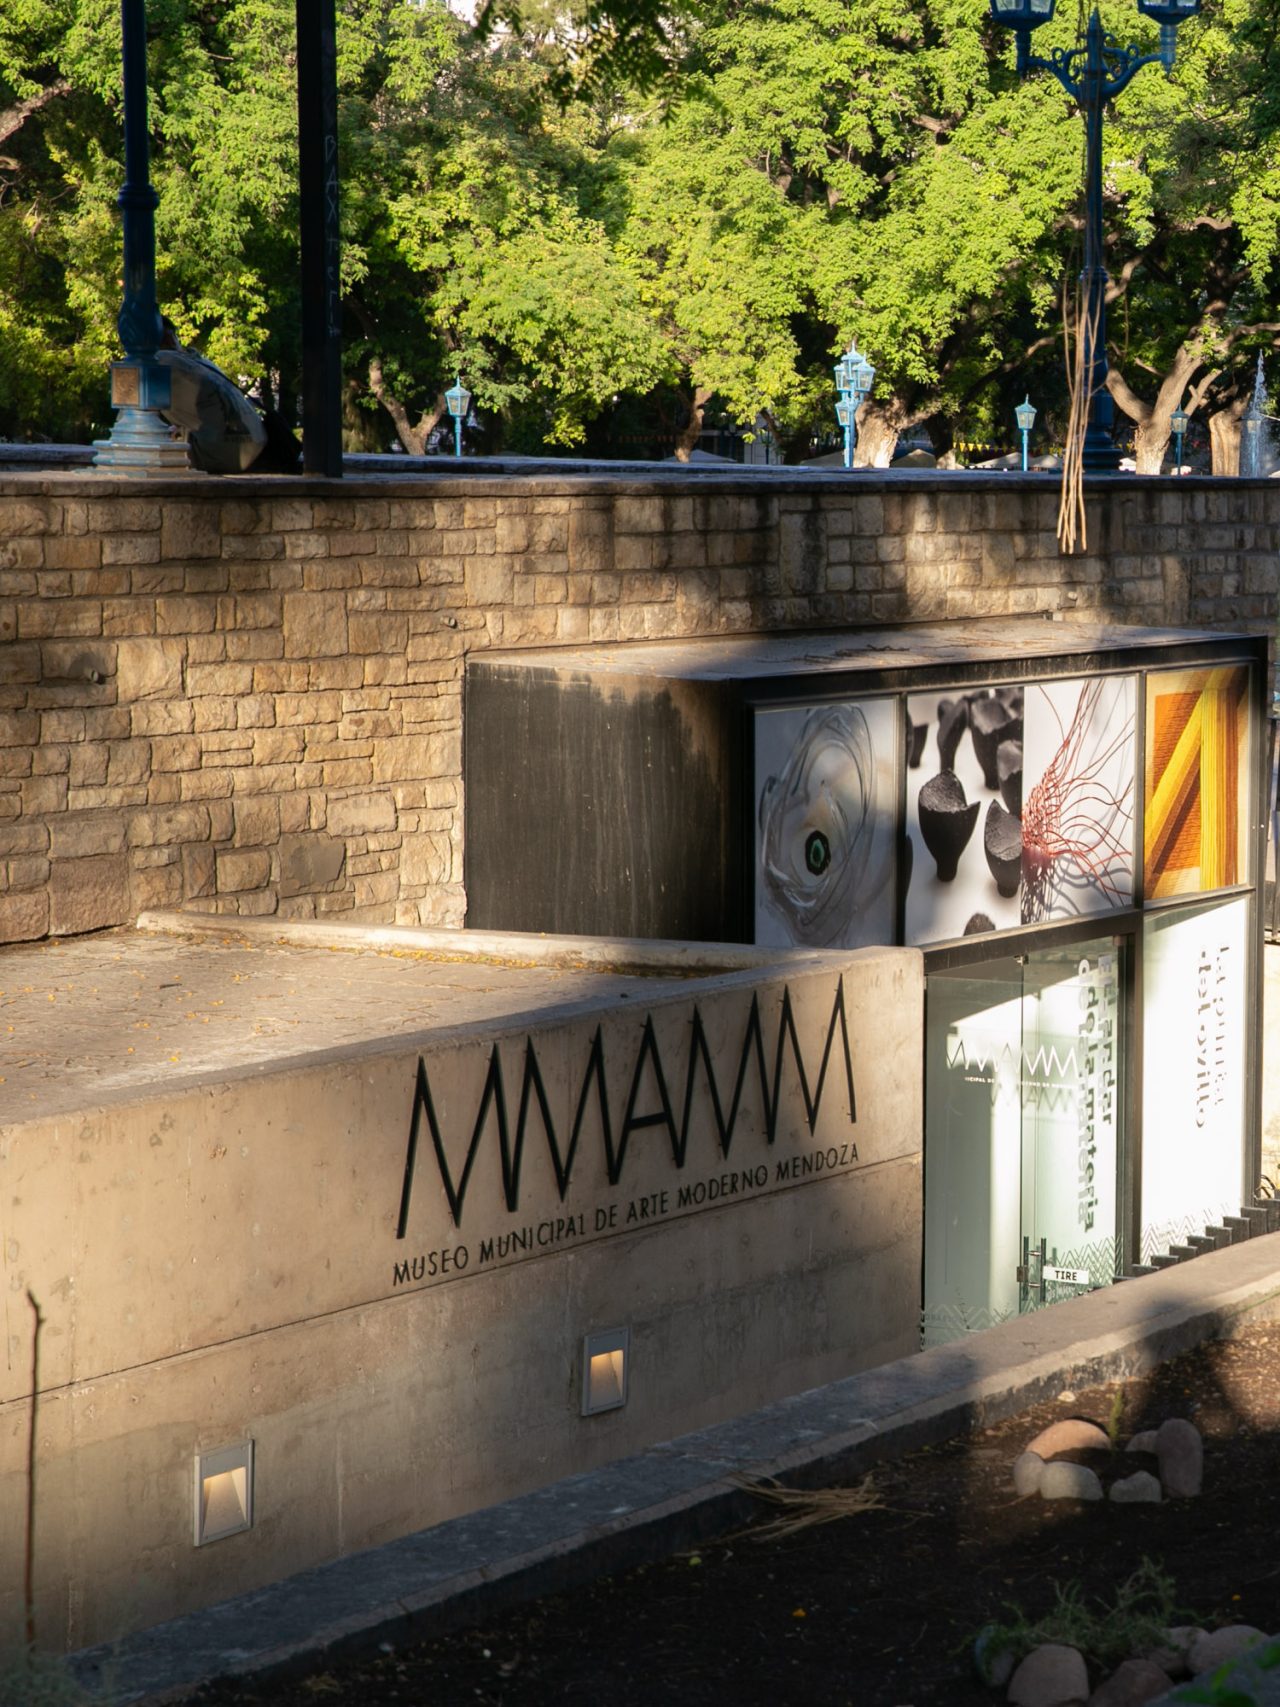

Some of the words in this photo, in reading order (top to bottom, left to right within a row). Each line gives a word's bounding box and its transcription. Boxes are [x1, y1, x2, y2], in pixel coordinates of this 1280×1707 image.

[396, 973, 857, 1239] MMAMM
[392, 1245, 470, 1287] MUSEO
[479, 1214, 585, 1264] MUNICIPAL
[594, 1206, 618, 1232] DE
[626, 1190, 670, 1224] ARTE
[677, 1164, 769, 1210] MODERNO
[776, 1142, 860, 1183] MENDOZA
[1054, 1270, 1078, 1281] TIRE
